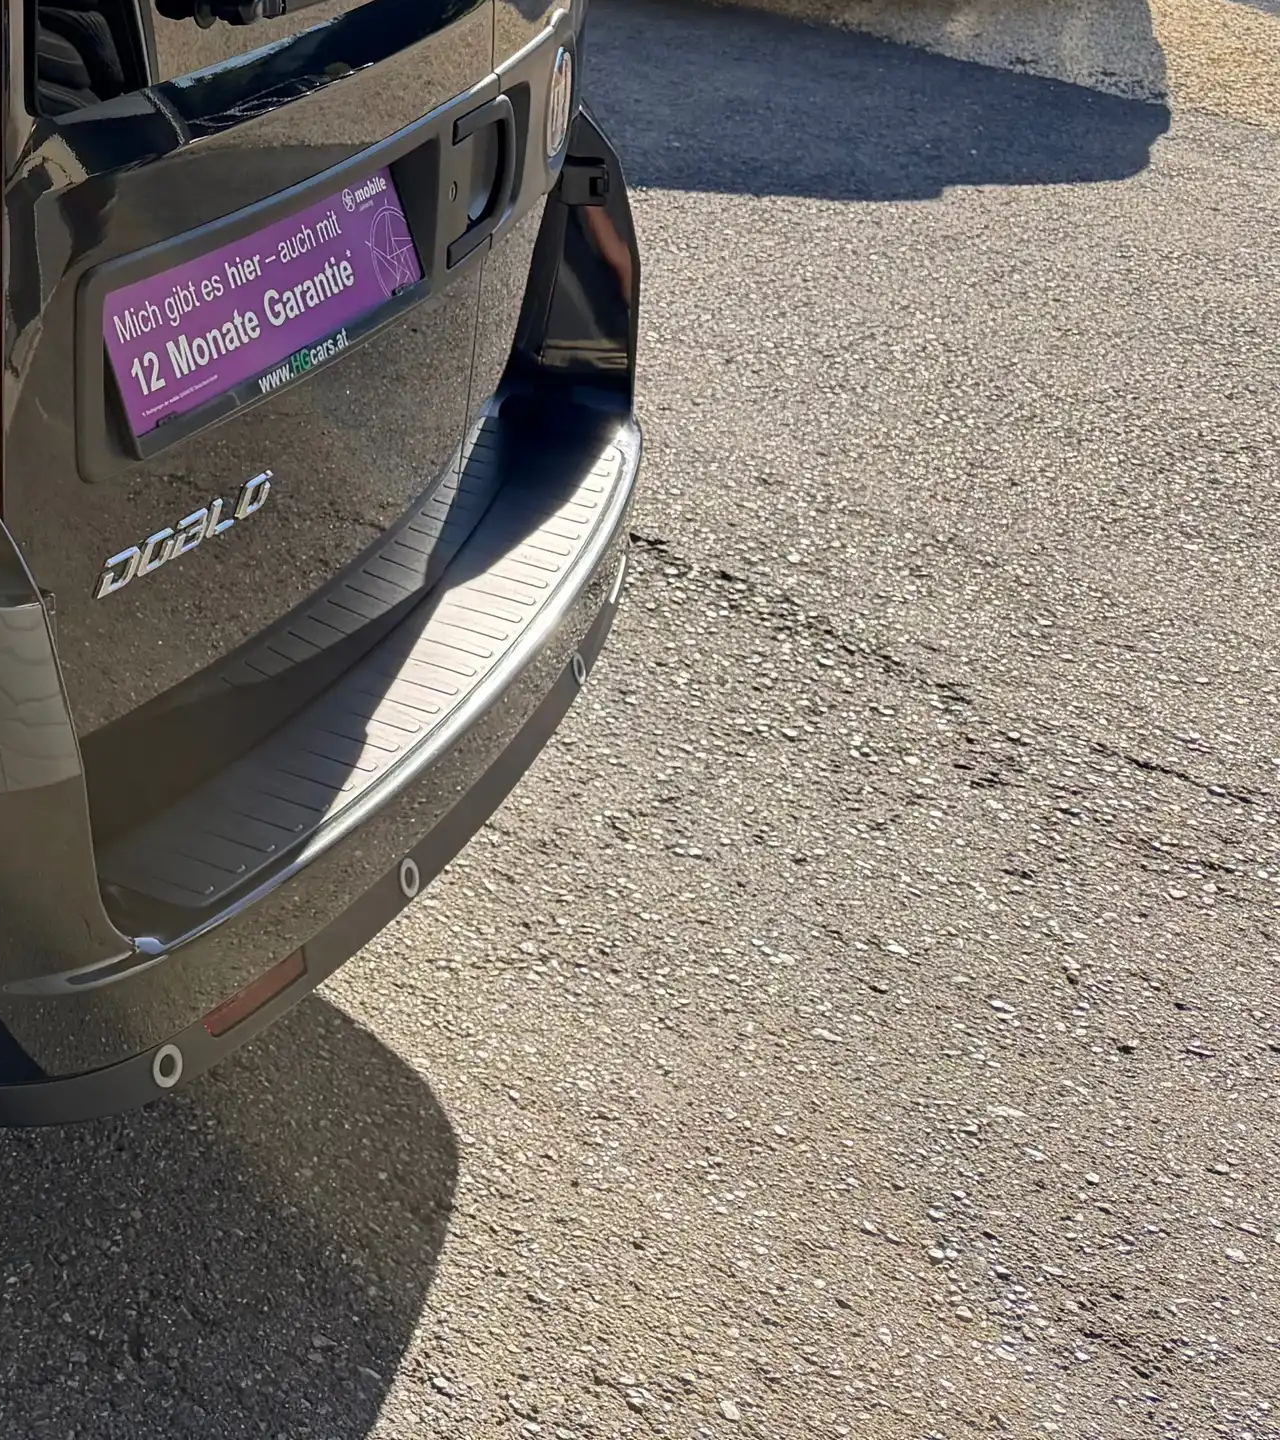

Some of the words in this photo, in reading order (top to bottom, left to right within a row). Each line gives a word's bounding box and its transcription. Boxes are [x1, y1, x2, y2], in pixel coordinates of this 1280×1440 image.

[354, 176, 387, 203] mobile
[113, 300, 164, 344] Mich
[163, 281, 201, 328] gibt
[200, 274, 225, 302] es
[224, 255, 262, 289] hier
[277, 225, 316, 264] auch
[316, 210, 343, 244] mit
[130, 350, 166, 396] 12
[165, 309, 262, 380] Monate
[257, 327, 349, 395] www.HGcars.at
